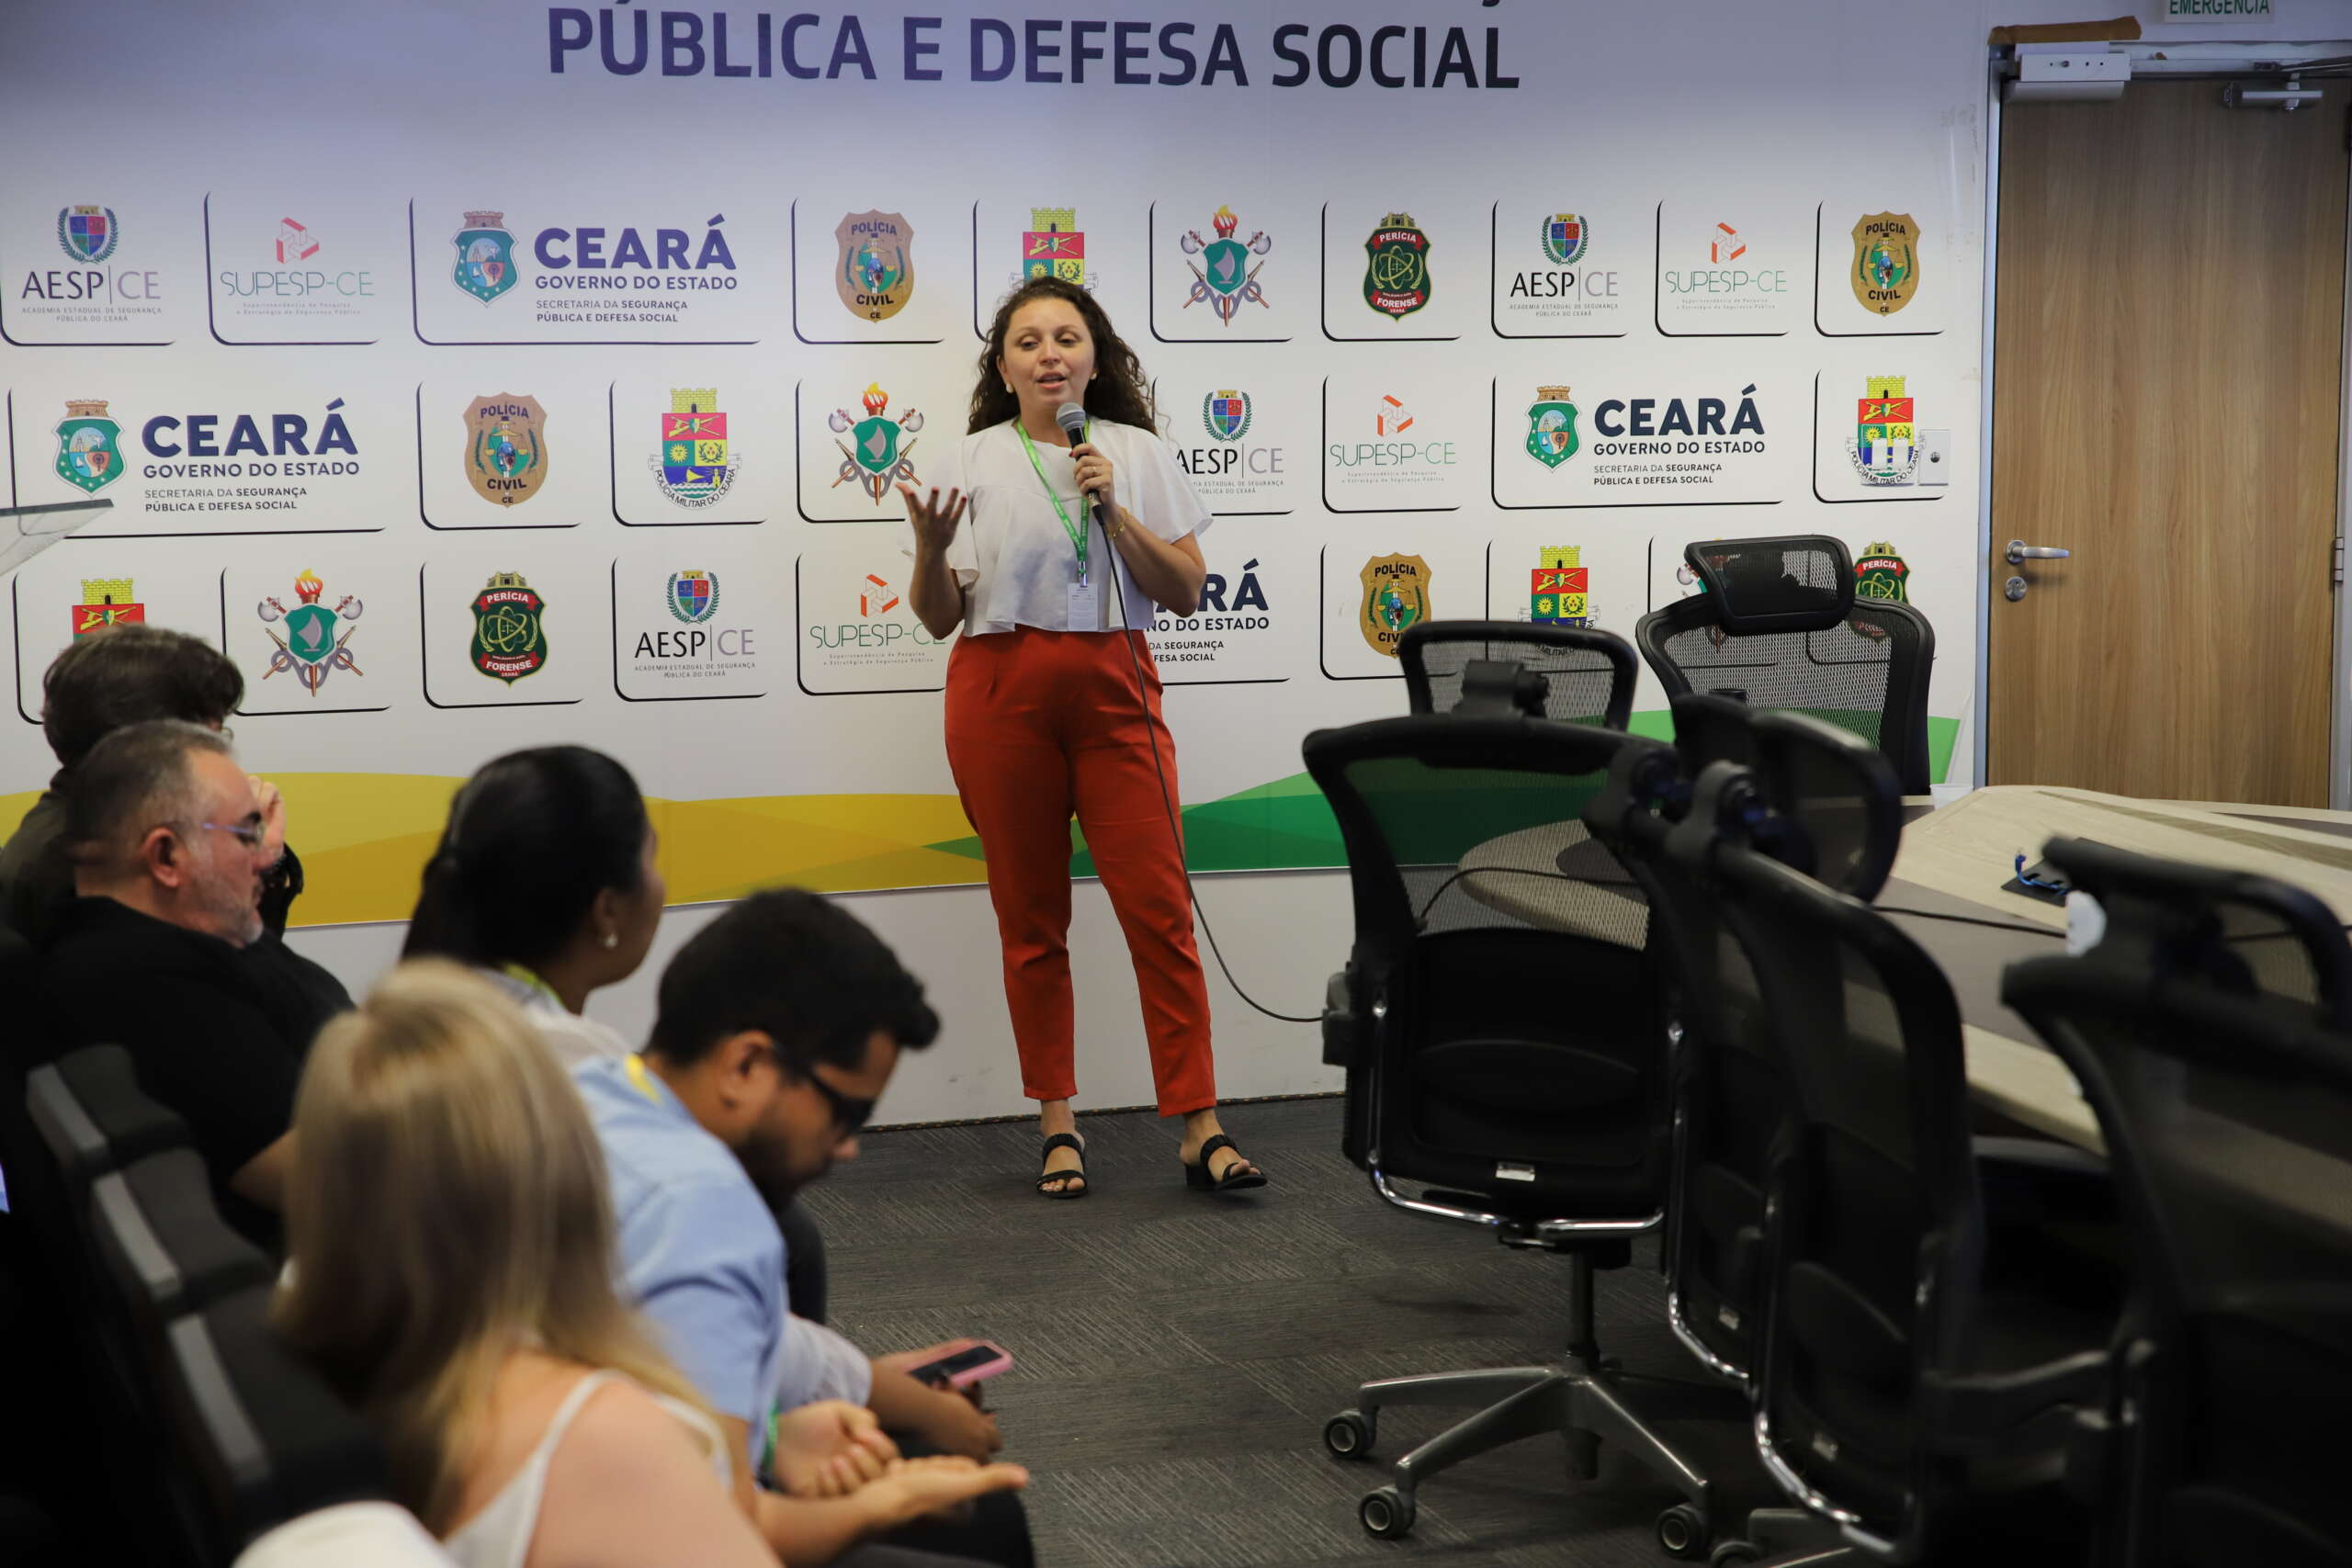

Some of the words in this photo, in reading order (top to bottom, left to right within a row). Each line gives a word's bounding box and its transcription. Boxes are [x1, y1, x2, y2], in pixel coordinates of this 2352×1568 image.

[903, 17, 943, 81] E
[970, 17, 1250, 86] DEFESA
[1272, 24, 1520, 88] SOCIAL
[851, 219, 897, 235] POLÍCIA
[1865, 220, 1906, 236] POLÍCIA
[534, 213, 737, 270] CEARÁ
[1379, 231, 1417, 243] PERÍCIA
[21, 271, 104, 299] AESP
[117, 271, 161, 299] CE
[220, 271, 375, 297] SUPESP-CE
[535, 276, 628, 289] GOVERNO
[633, 276, 661, 289] DO
[666, 276, 738, 290] ESTADO
[1510, 272, 1575, 298] AESP
[1585, 271, 1619, 297] CE
[1665, 270, 1787, 293] SUPESP-CE
[856, 294, 894, 306] CIVIL
[1868, 289, 1902, 300] CIVIL
[536, 299, 601, 310] SECRETARIA
[604, 299, 618, 309] DA
[621, 300, 687, 311] SEGURANÇA
[1376, 297, 1418, 308] FORENSE
[537, 310, 583, 322] PÚBLICA
[586, 313, 593, 321] E
[594, 313, 637, 321] DEFESA
[639, 313, 678, 322] SOCIAL
[480, 402, 529, 419] POLÍCIA
[1594, 383, 1765, 437] CEARÁ
[141, 397, 358, 458] CEARÁ
[1329, 443, 1457, 467] SUPESP-CE
[1594, 442, 1672, 456] GOVERNO
[1677, 442, 1700, 454] DO
[1705, 441, 1765, 454] ESTADO
[1176, 448, 1238, 474] AESP
[1249, 447, 1284, 473] CE
[143, 463, 243, 479] GOVERNO
[249, 463, 277, 477] DO
[284, 461, 359, 476] ESTADO
[1594, 464, 1648, 474] SECRETARIA
[1650, 464, 1663, 472] DA
[1666, 463, 1722, 474] SEGURANÇA
[487, 478, 527, 491] CIVIL
[1594, 475, 1634, 485] PÚBLICA
[1635, 477, 1641, 485] E
[1644, 476, 1678, 484] DEFESA
[1680, 476, 1713, 484] SOCIAL
[144, 489, 214, 499] SECRETARIA
[217, 489, 232, 498] DA
[236, 487, 307, 499] SEGURANÇA
[674, 496, 707, 508] MILITAR
[707, 493, 720, 505] DO
[145, 500, 196, 512] PÚBLICA
[208, 502, 253, 512] DEFESA
[254, 501, 298, 510] SOCIAL
[1374, 561, 1417, 578] POLÍCIA
[1862, 559, 1897, 570] PERÍCIA
[486, 592, 529, 604] PERÍCIA
[1176, 619, 1200, 631] DO
[1204, 616, 1270, 631] ESTADO
[634, 631, 706, 659] AESP
[718, 629, 755, 656] CE
[1378, 632, 1401, 643] CIV
[1148, 642, 1161, 650] DA
[1164, 640, 1225, 651] SEGURANÇA
[1154, 654, 1177, 662] FESA
[1180, 653, 1216, 661] SOCIAL
[486, 660, 533, 671] FORENSE
